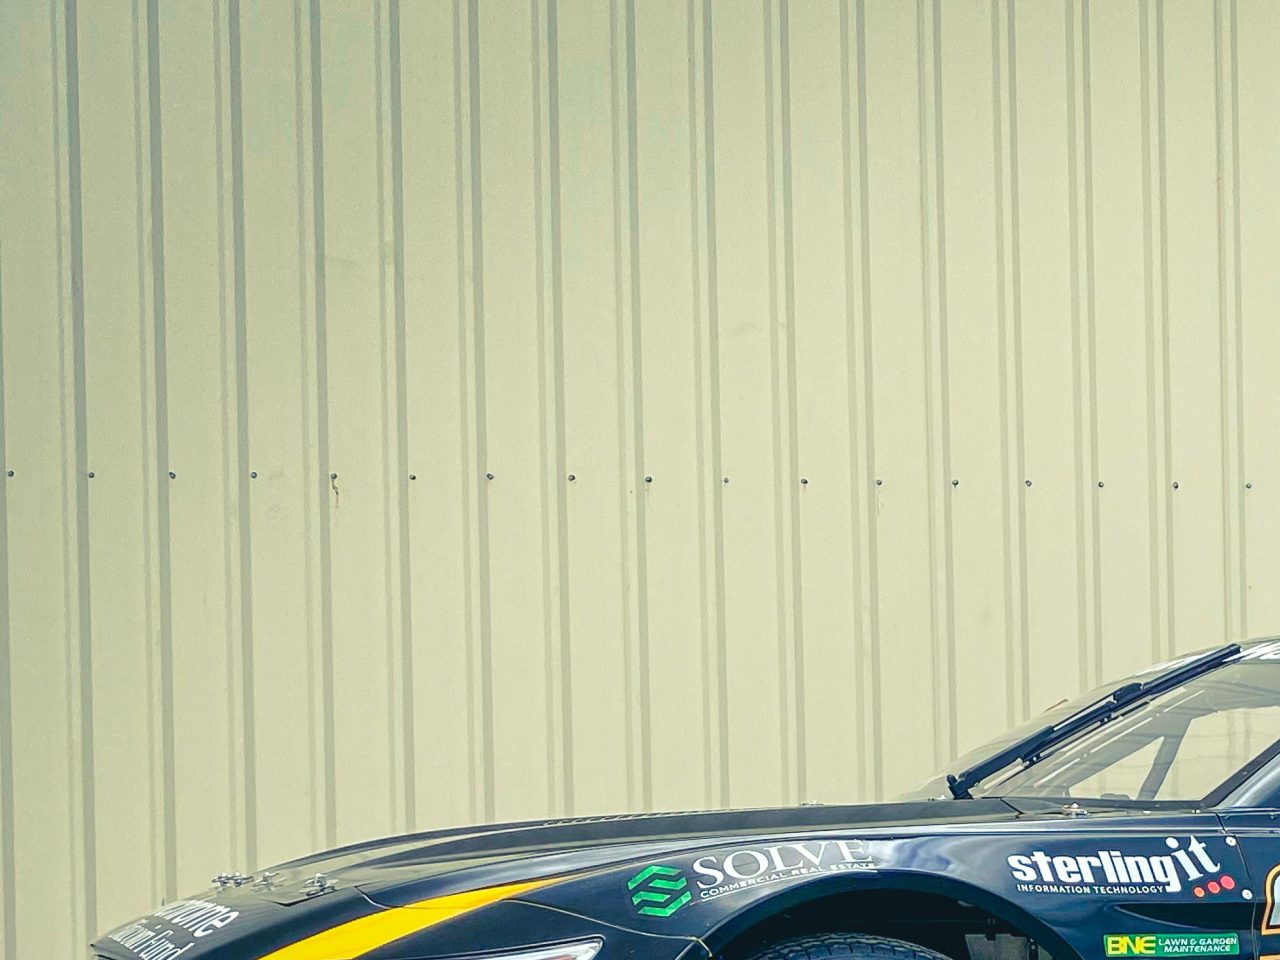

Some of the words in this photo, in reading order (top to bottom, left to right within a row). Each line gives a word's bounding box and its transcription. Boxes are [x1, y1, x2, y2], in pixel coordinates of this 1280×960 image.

[692, 839, 873, 890] SOLVE
[700, 871, 787, 899] COMMERCIAL
[791, 864, 823, 876] REAL
[1016, 883, 1091, 894] INFORMATION
[1093, 885, 1165, 894] TECHNOLOGY
[1106, 934, 1158, 955] BNE
[1158, 937, 1188, 946] LAWN
[1199, 937, 1238, 946] GARDEN
[1163, 944, 1232, 953] MAINTENANCE
